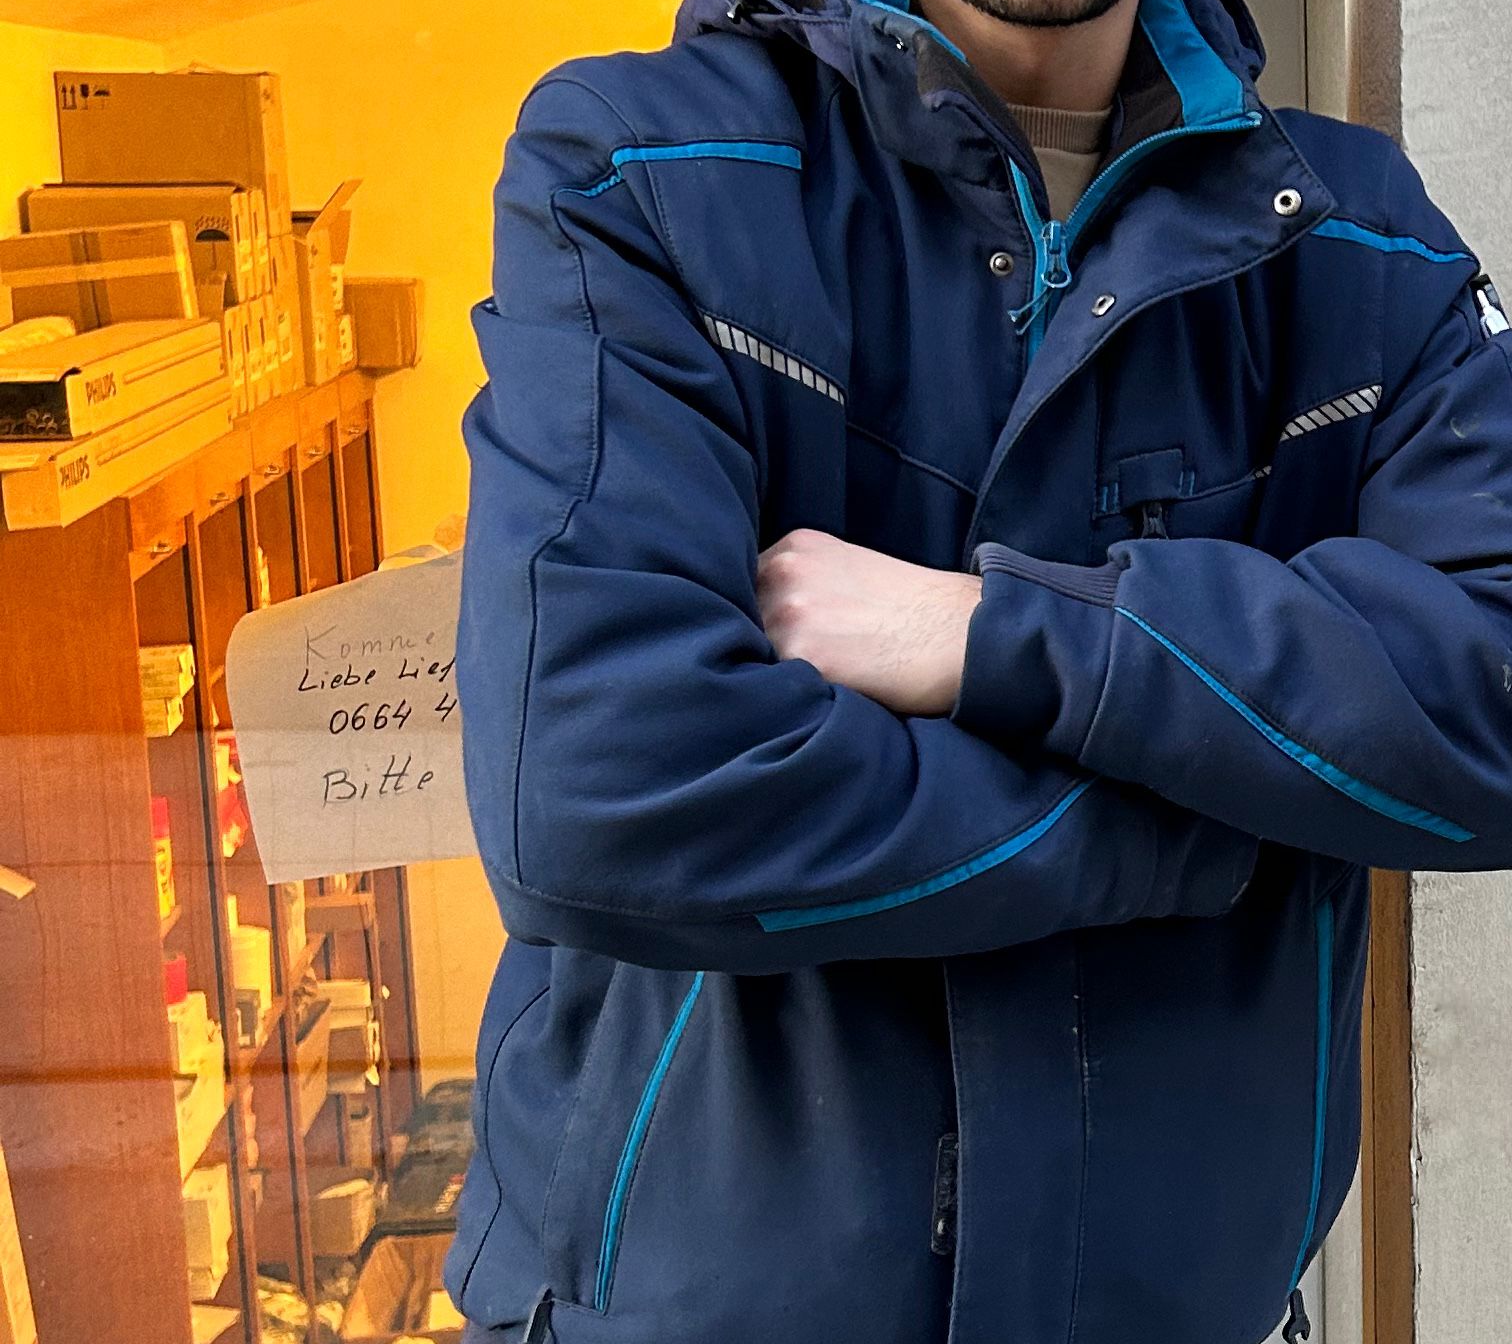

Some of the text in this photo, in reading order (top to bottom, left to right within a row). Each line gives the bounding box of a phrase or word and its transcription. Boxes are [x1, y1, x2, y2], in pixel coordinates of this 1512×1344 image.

[298, 664, 376, 692] Liebe
[329, 699, 412, 735] 0664
[322, 755, 434, 807] Bitte
